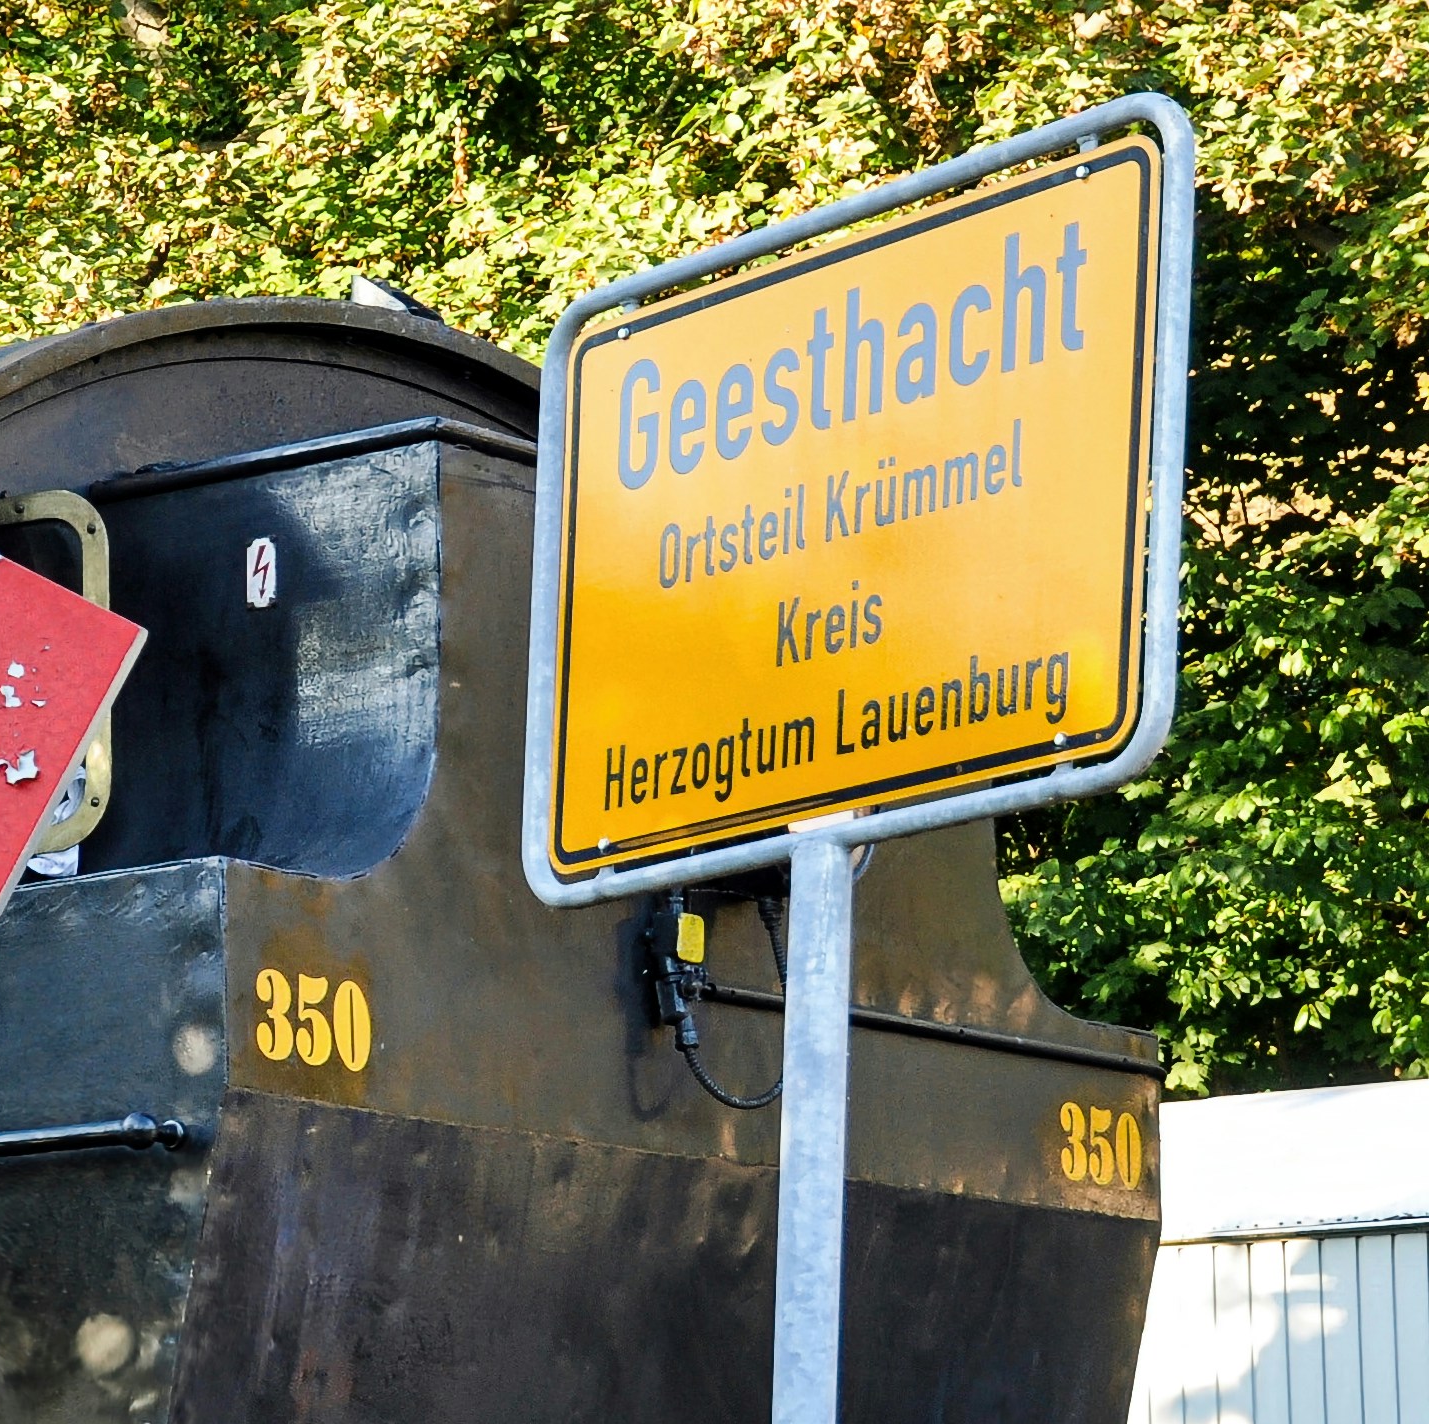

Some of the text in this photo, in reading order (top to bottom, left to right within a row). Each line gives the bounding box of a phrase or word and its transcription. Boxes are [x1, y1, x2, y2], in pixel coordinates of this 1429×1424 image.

[618, 221, 1087, 490] Geesthacht
[659, 419, 1022, 590] Ortsteil Krümmel
[776, 582, 883, 667] Kreis
[604, 649, 1069, 811] Herzogtum Lauenburg
[256, 968, 371, 1072] 350
[1060, 1101, 1141, 1191] 350
